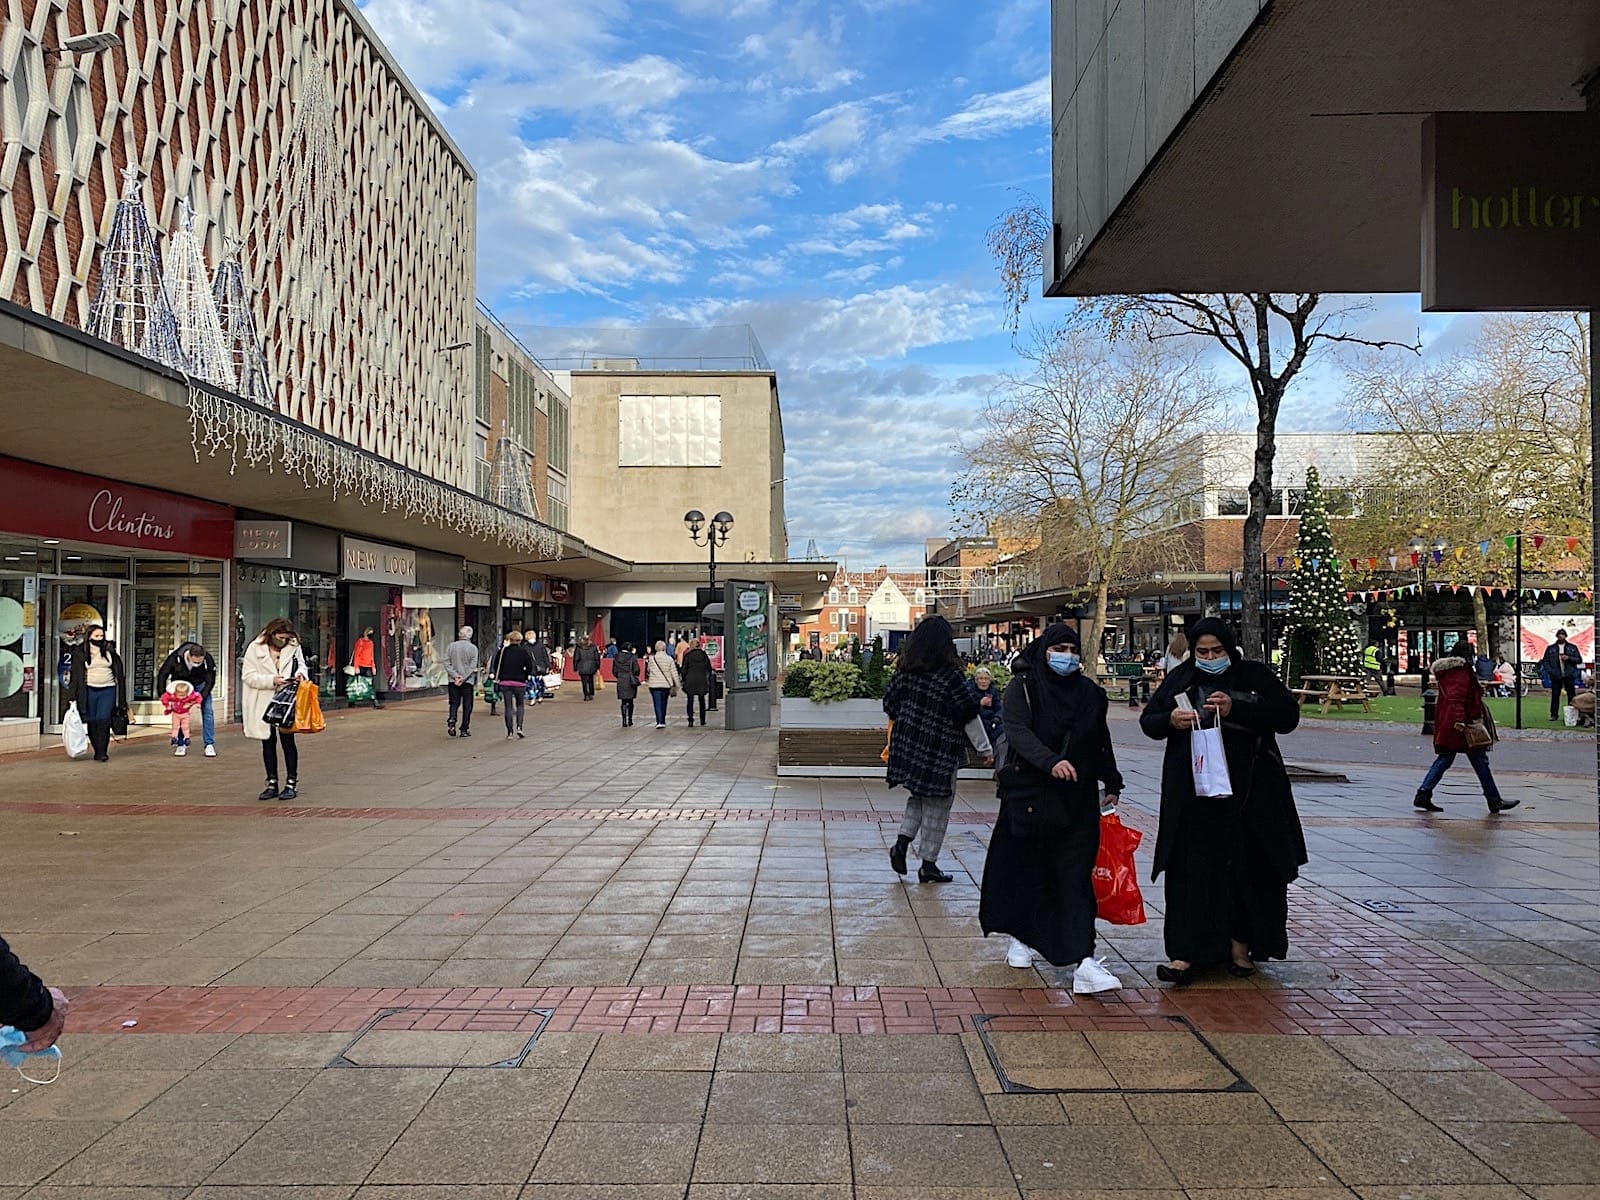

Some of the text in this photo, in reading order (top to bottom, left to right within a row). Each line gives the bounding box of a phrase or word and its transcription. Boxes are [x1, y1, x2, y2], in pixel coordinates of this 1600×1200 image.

[88, 489, 174, 539] Clintons
[242, 528, 280, 537] NEW
[239, 540, 281, 550] LOOK
[346, 549, 415, 577] NEW LOOK
